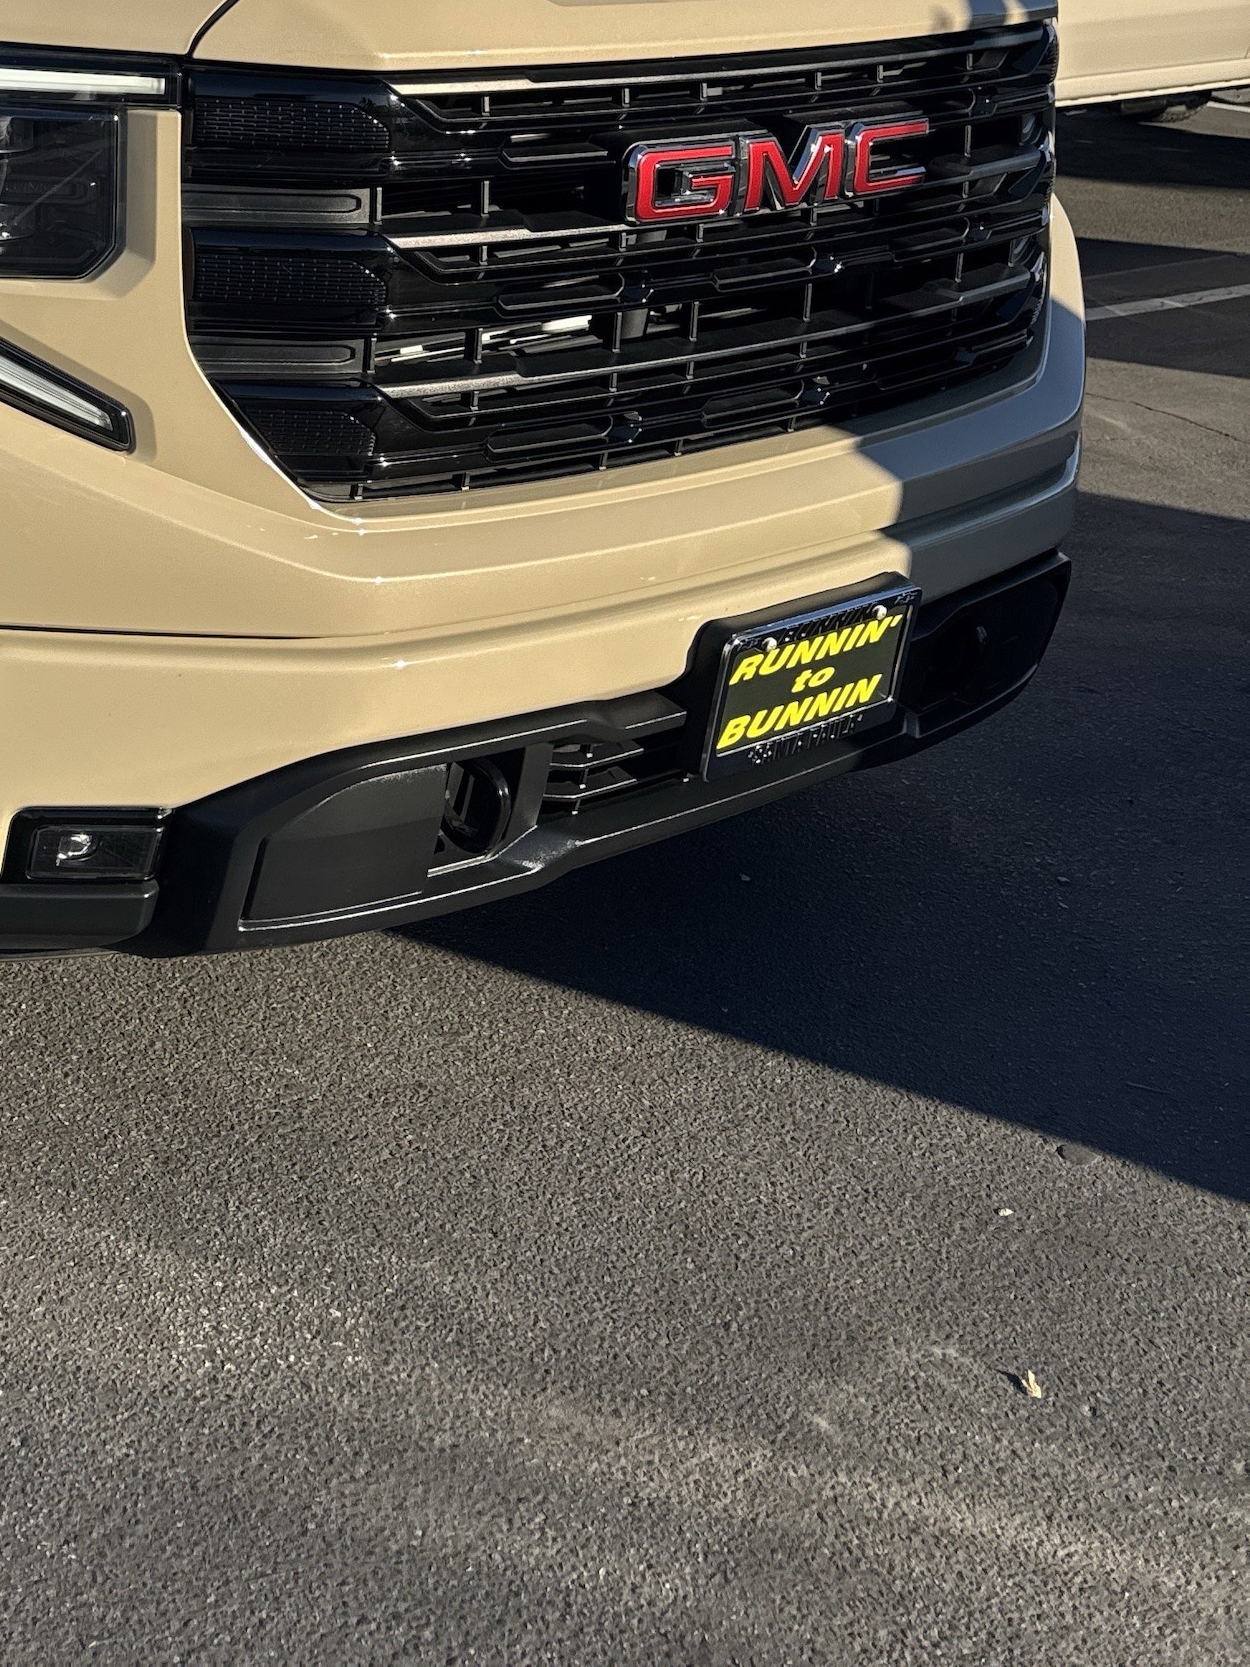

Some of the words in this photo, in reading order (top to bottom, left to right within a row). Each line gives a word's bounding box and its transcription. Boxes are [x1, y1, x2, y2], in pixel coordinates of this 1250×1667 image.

[623, 116, 930, 226] GMC
[716, 673, 884, 751] BUNNIN
[791, 666, 836, 694] to
